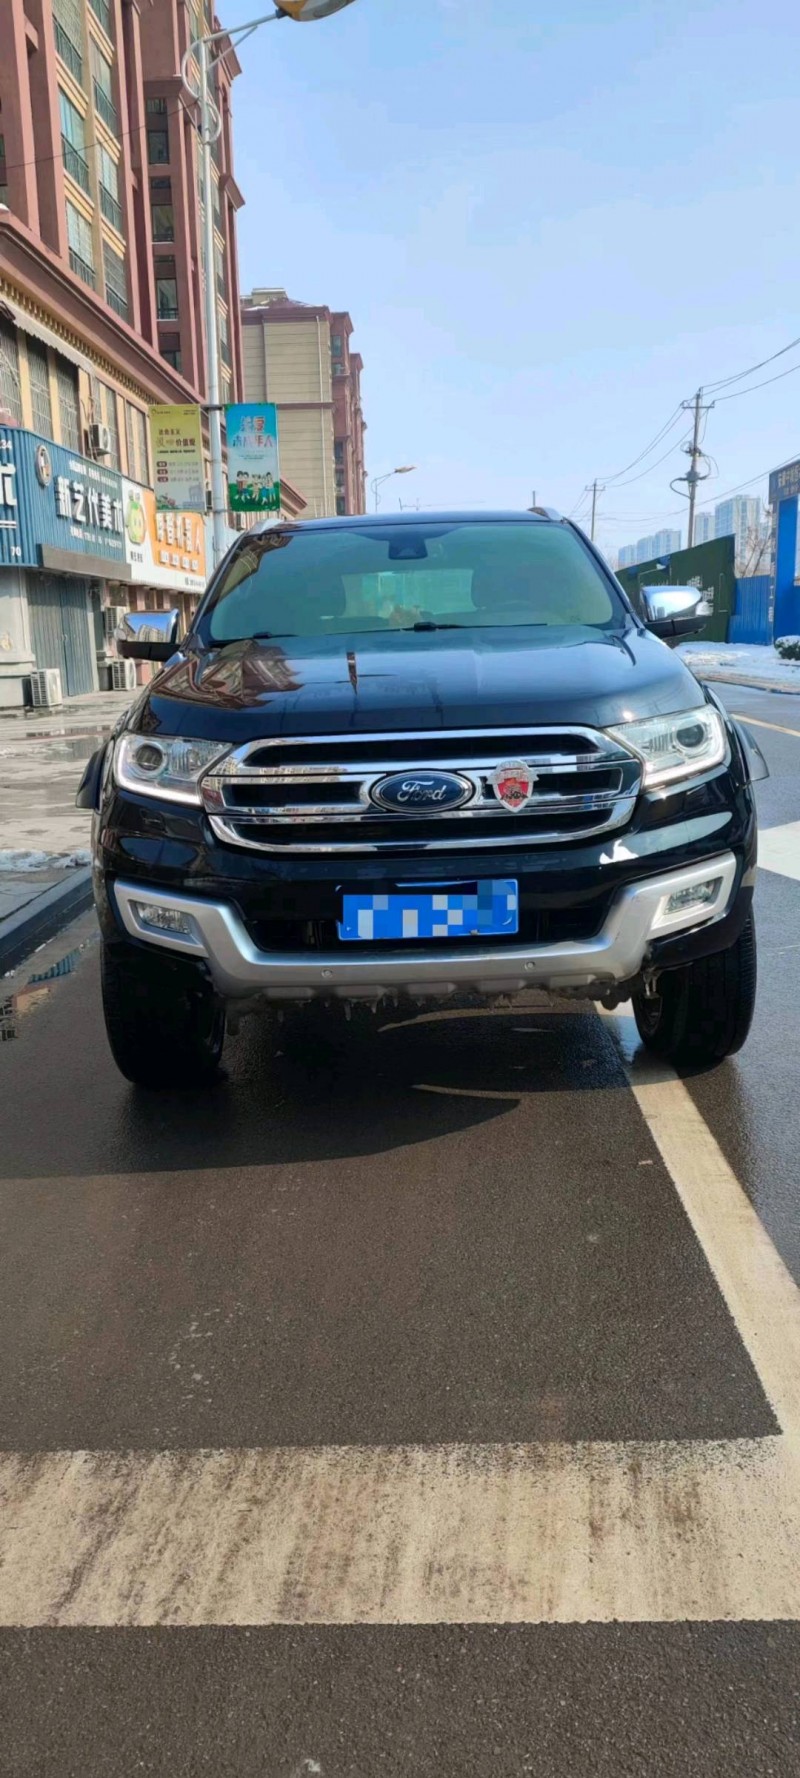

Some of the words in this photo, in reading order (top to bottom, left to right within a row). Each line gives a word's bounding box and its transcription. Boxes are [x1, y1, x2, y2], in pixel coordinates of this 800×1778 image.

[57, 475, 124, 533] 新艺代美术
[396, 780, 447, 803] Ford
